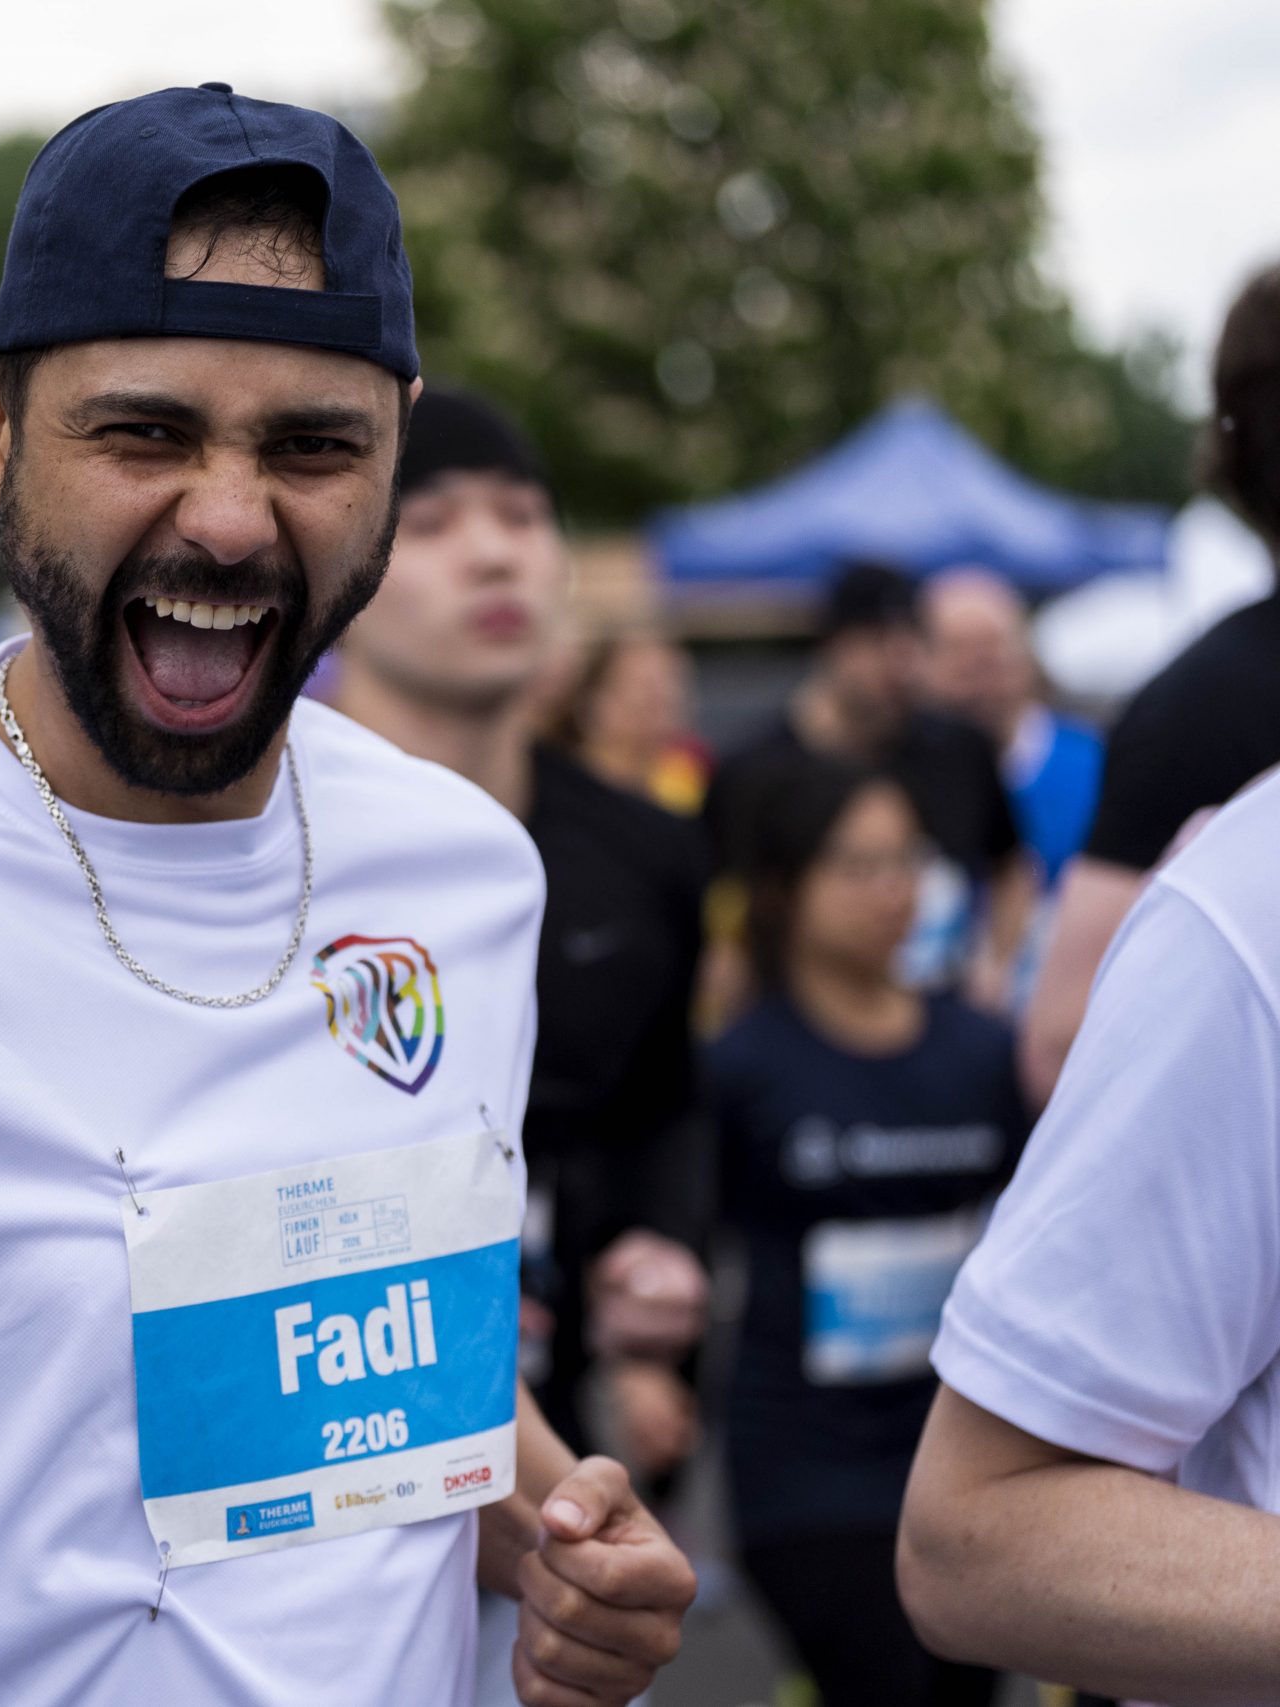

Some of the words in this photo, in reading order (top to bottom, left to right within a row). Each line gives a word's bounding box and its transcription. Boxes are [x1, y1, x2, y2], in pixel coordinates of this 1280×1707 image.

[277, 1177, 335, 1201] THERME
[278, 1196, 337, 1217] EUSKIRCHEN
[284, 1216, 320, 1237] FIRMEN
[286, 1232, 320, 1259] LAUF
[275, 1278, 438, 1396] Fadi
[322, 1408, 409, 1461] 2206
[259, 1500, 308, 1520] THERME
[259, 1513, 310, 1531] EUSKIRCHEN
